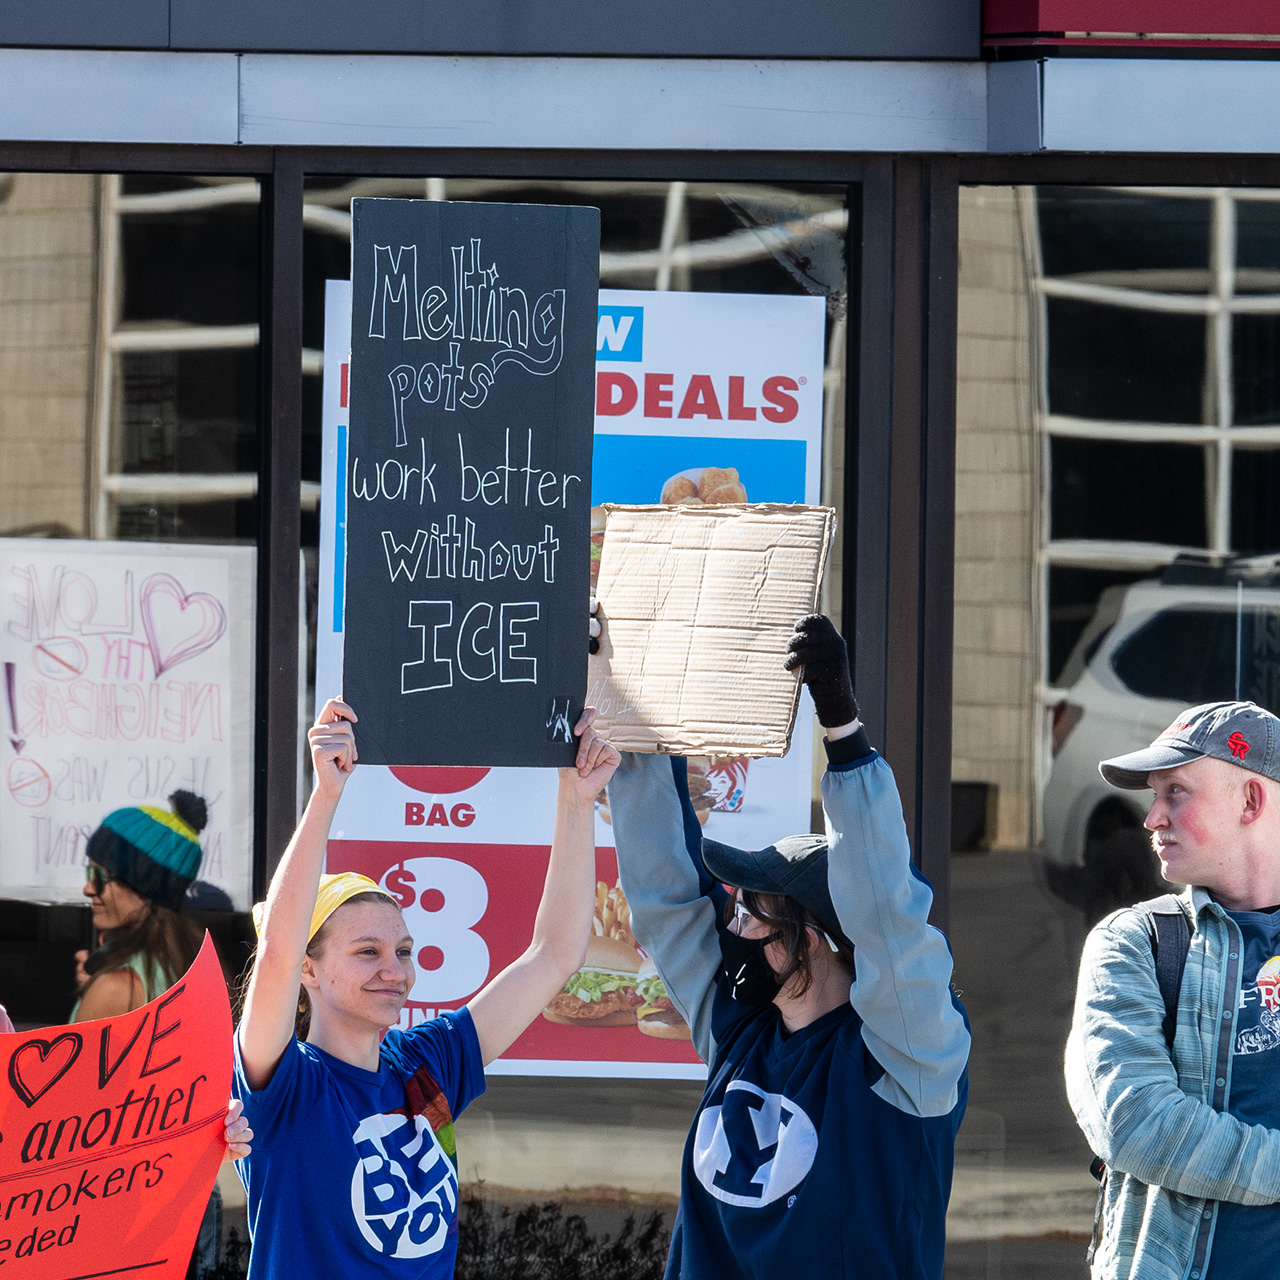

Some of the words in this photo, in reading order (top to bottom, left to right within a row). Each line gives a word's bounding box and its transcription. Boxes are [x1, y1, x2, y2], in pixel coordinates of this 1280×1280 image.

[369, 238, 566, 376] Melting
[388, 342, 494, 447] pots
[353, 437, 438, 505] work
[458, 427, 582, 508] better
[382, 514, 559, 583] without
[401, 600, 540, 695] ICE
[405, 802, 476, 828] BAG
[20, 1074, 207, 1165] another
[357, 1119, 450, 1216] BE
